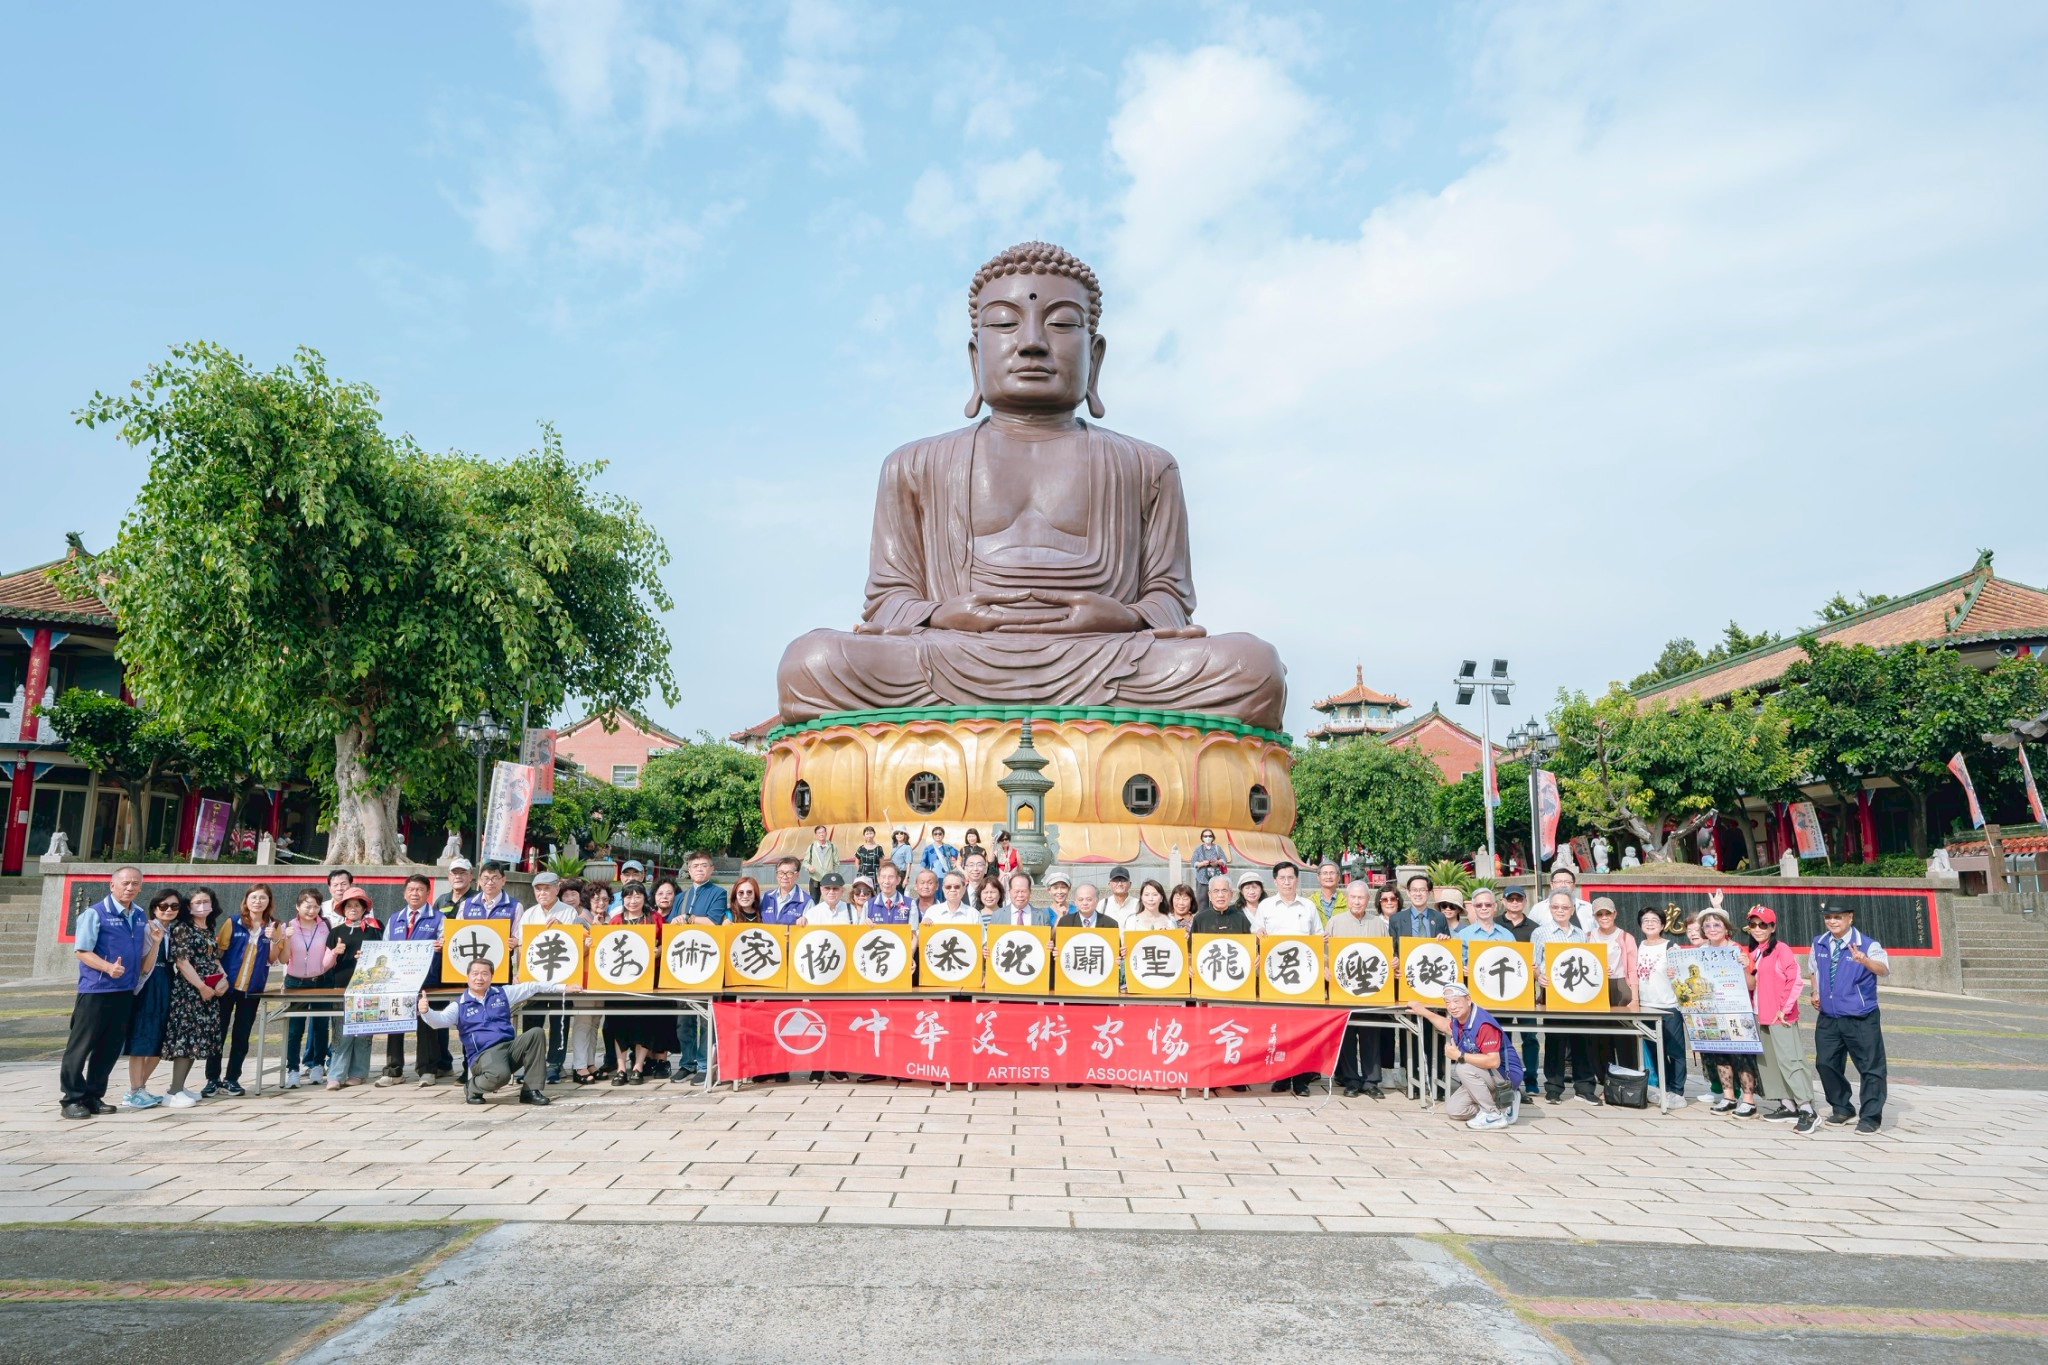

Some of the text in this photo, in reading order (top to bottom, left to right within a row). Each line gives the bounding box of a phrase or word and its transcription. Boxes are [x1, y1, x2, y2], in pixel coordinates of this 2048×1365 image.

[458, 931, 492, 960] 中
[532, 933, 571, 982] 華
[671, 939, 717, 972] 術
[740, 931, 781, 975] 家
[801, 938, 841, 980] 協
[862, 935, 897, 977] 會
[933, 936, 971, 971] 恭
[1000, 940, 1036, 976] 祝
[1072, 945, 1104, 976] 關
[1141, 945, 1176, 978] 聖
[1202, 943, 1245, 982] 龍
[1272, 946, 1302, 985] 君
[1345, 950, 1380, 996] 聖
[1416, 954, 1449, 987] 誕
[1488, 956, 1516, 998] 千
[1559, 955, 1600, 992] 秋
[906, 1062, 1189, 1084] CHINA ARTISTS ASSOCIATION
